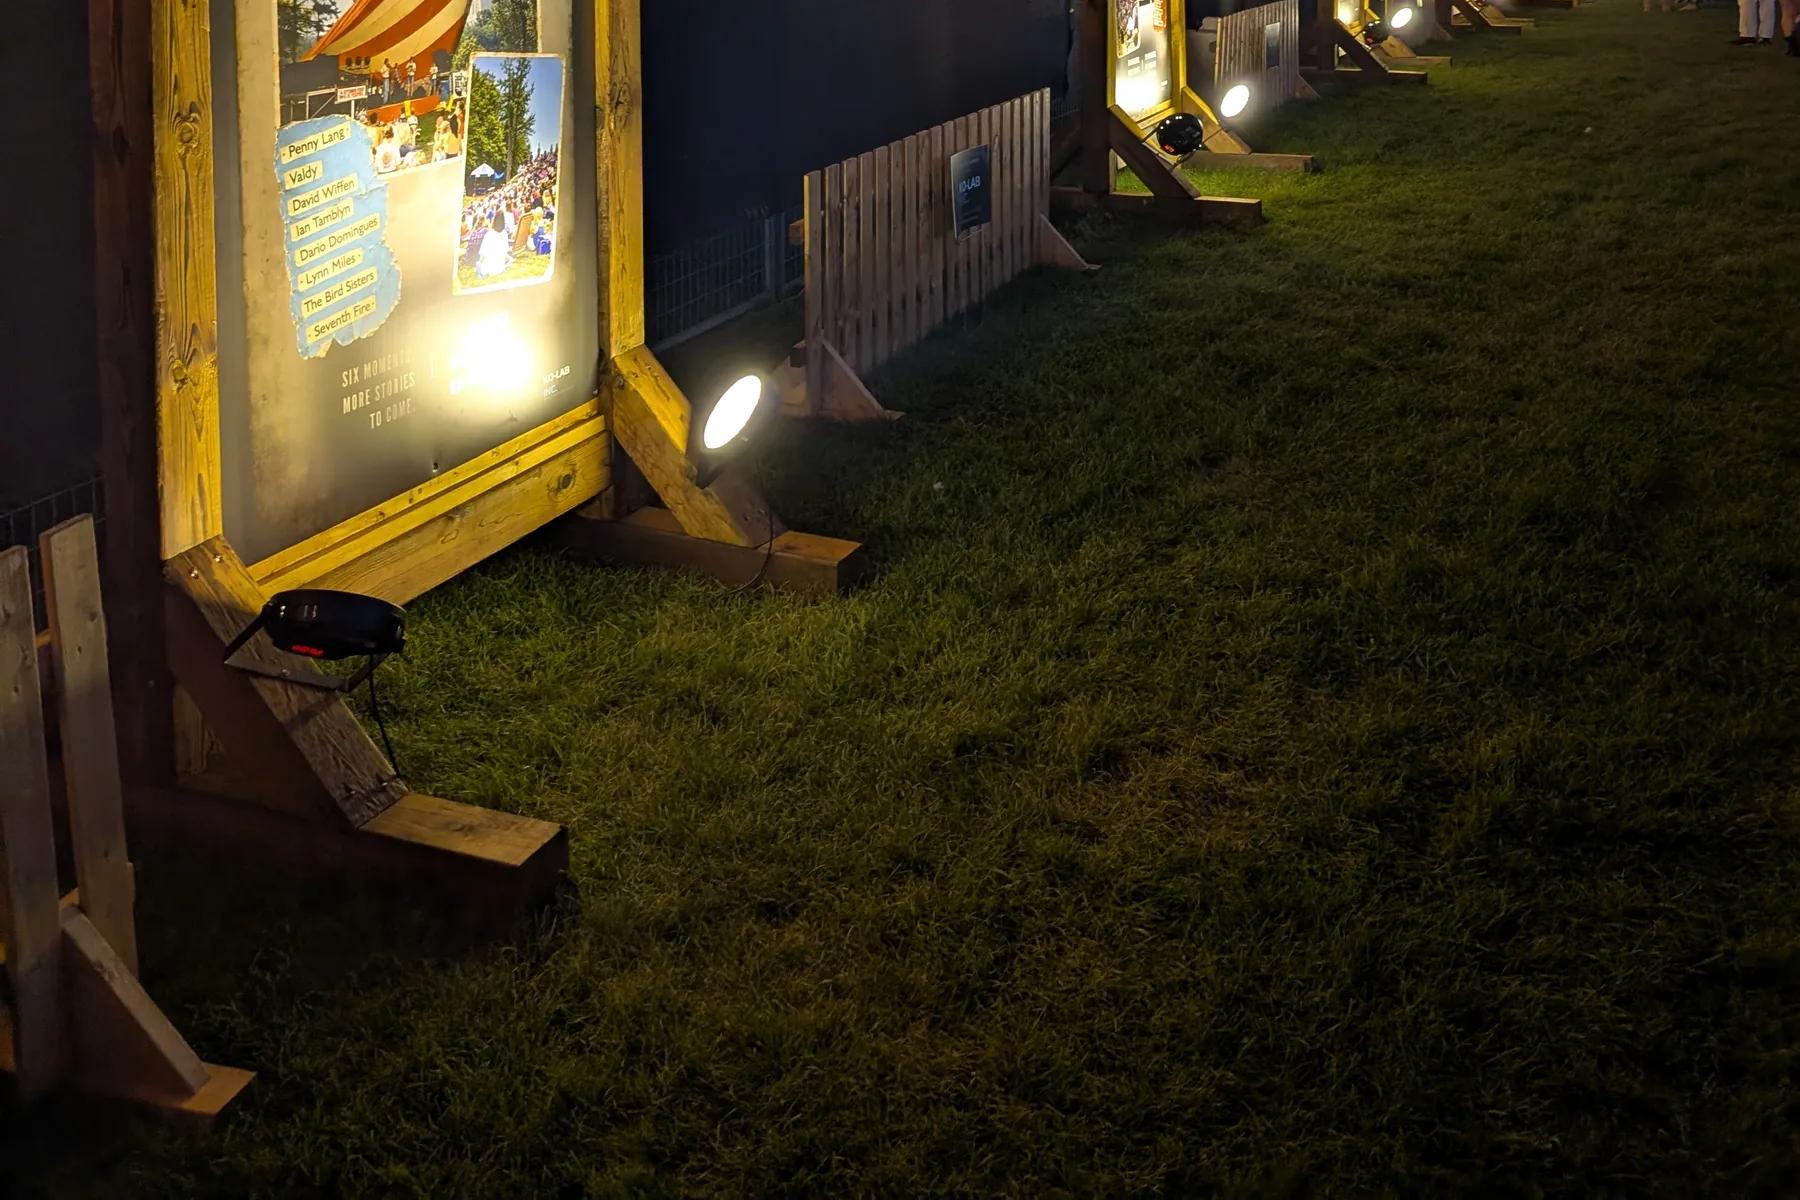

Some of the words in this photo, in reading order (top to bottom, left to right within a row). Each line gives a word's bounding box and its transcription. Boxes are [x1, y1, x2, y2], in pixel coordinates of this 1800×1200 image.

[288, 137, 319, 157] Penny
[321, 127, 345, 146] Lang
[289, 164, 318, 184] Valdy
[292, 190, 320, 212] David
[322, 179, 355, 201] Wiffen
[295, 223, 311, 237] Ian
[312, 205, 351, 229] Tamblyn
[328, 217, 378, 247] Domingues
[306, 268, 329, 285] Lynn
[331, 254, 355, 273] Miles
[304, 297, 323, 313] The
[325, 285, 345, 306] Bird
[346, 273, 375, 295] Sisters
[313, 313, 351, 338] Seventh
[353, 304, 371, 321] Fire
[342, 366, 360, 388] SIX
[343, 388, 371, 415] MORE
[374, 371, 416, 402] STORIES
[369, 410, 382, 430] TO
